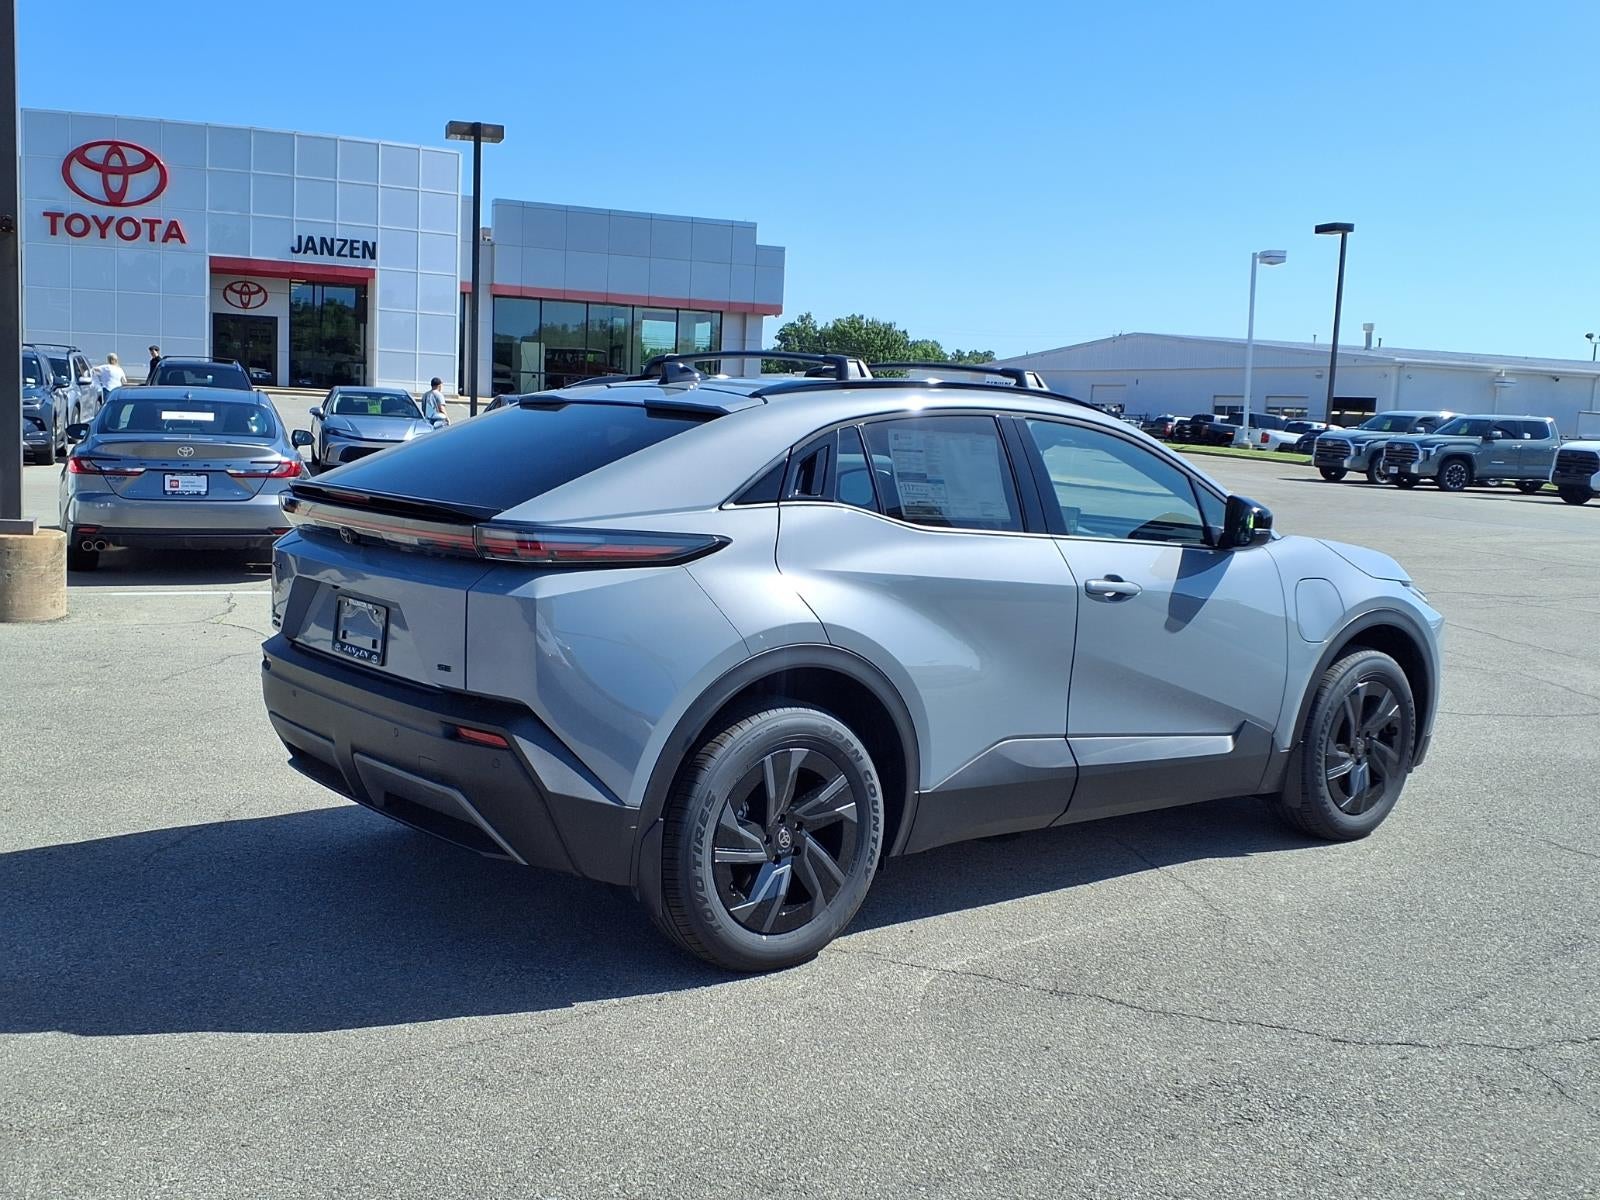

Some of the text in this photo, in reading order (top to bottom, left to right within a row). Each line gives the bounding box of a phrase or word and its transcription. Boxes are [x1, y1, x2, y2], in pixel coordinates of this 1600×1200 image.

[42, 211, 186, 244] TOYOTA
[290, 235, 376, 260] JANZEN
[343, 645, 369, 658] JANZEN
[818, 724, 882, 881] OPEN COUNTRY
[692, 790, 717, 871] TIRES
